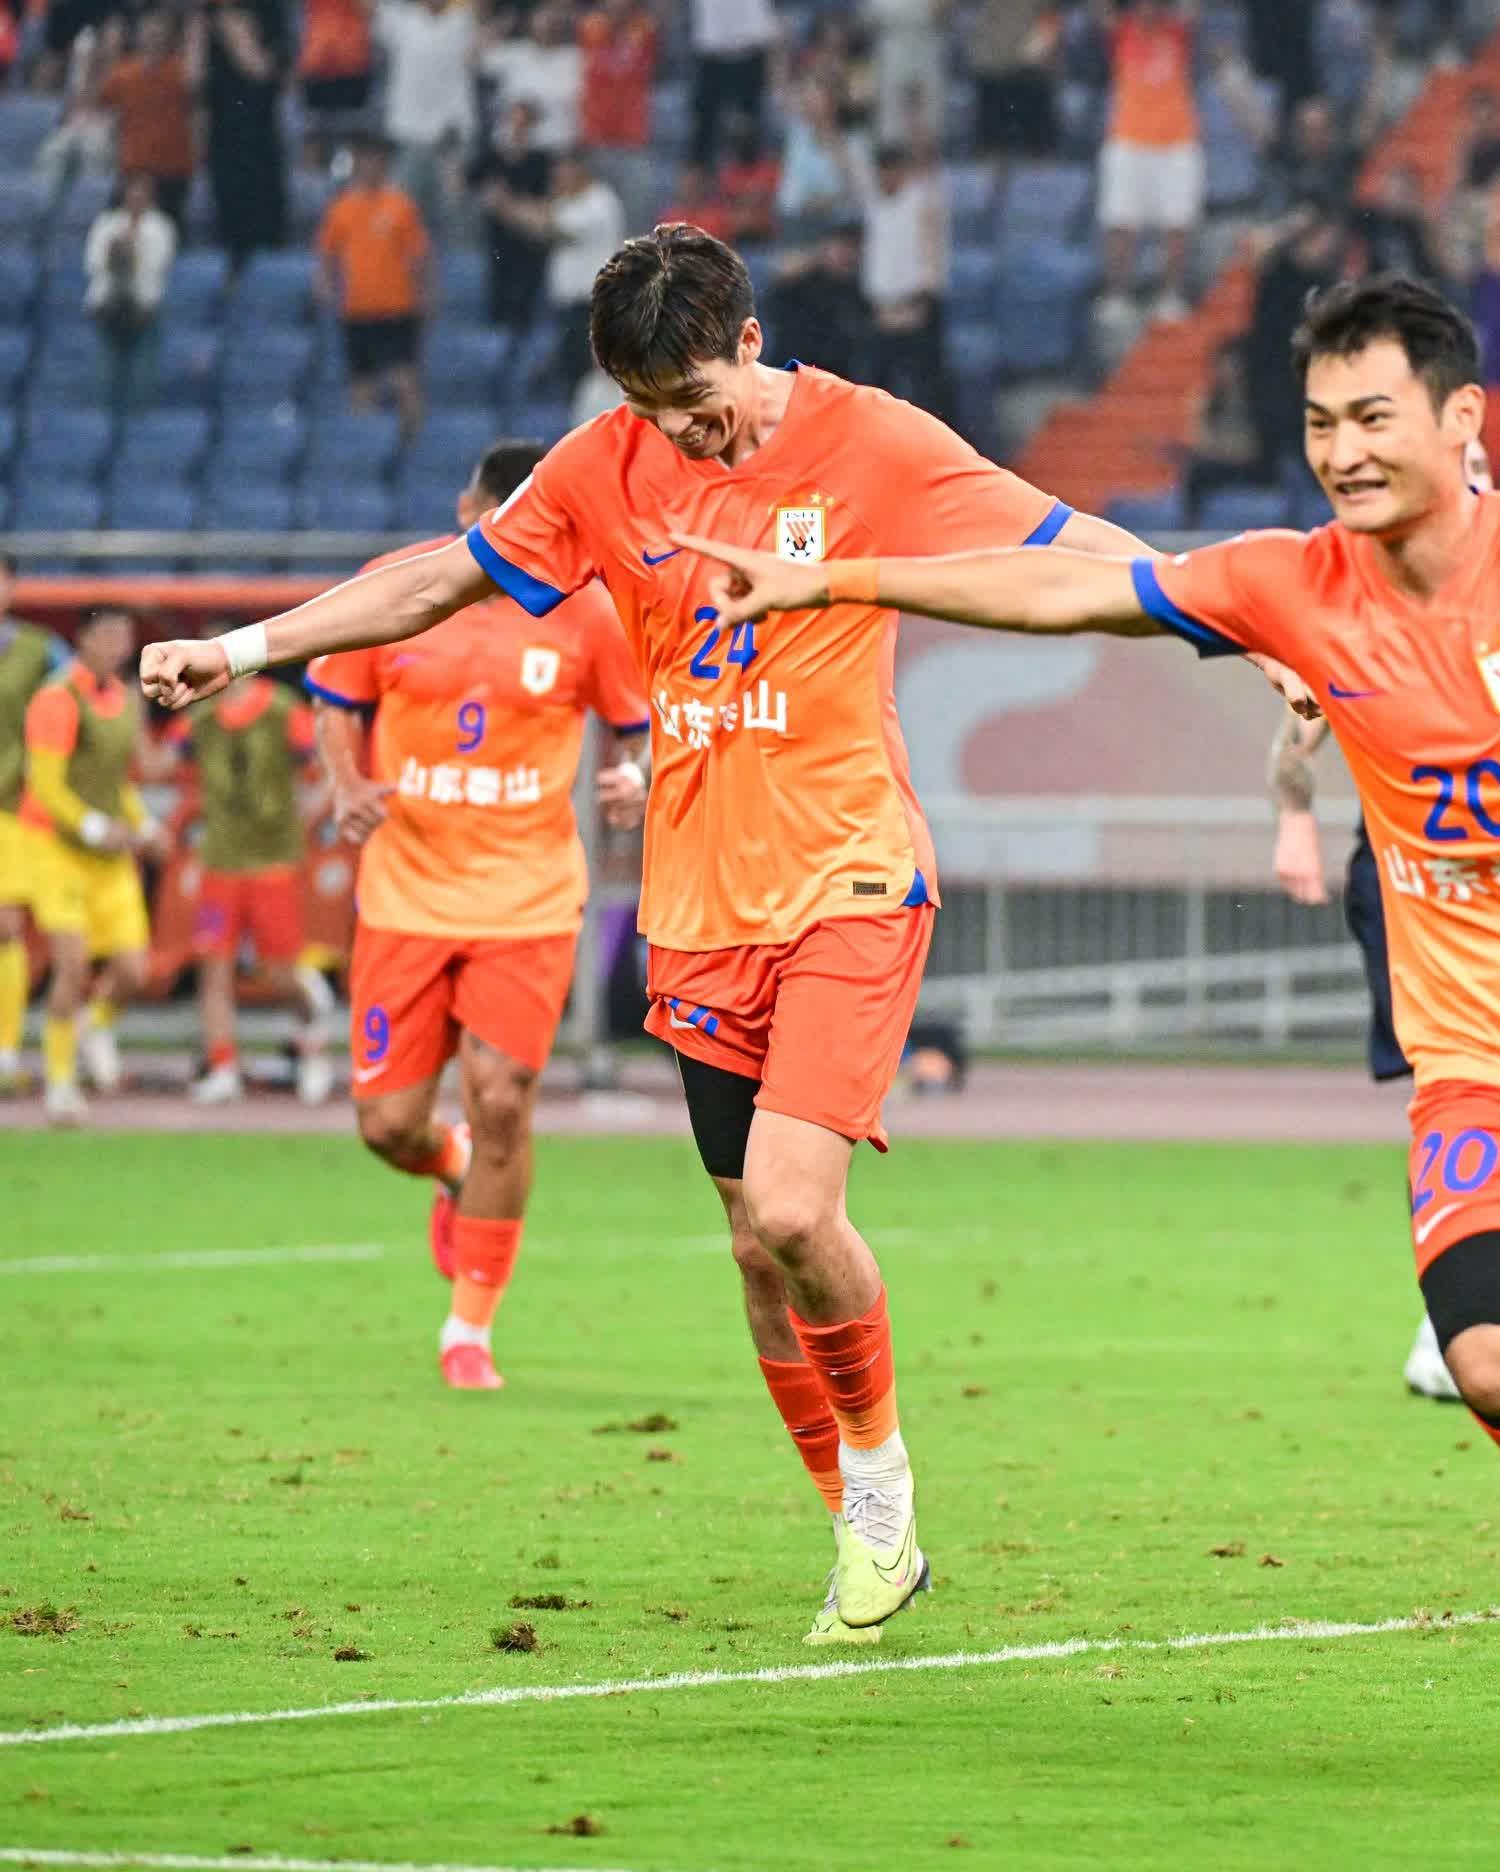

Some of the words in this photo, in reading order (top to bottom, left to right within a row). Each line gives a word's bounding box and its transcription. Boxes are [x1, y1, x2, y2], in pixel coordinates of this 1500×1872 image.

[689, 606, 760, 680] 24
[456, 701, 485, 752] 9
[365, 1005, 390, 1062] 9
[1412, 1127, 1499, 1217] 20
